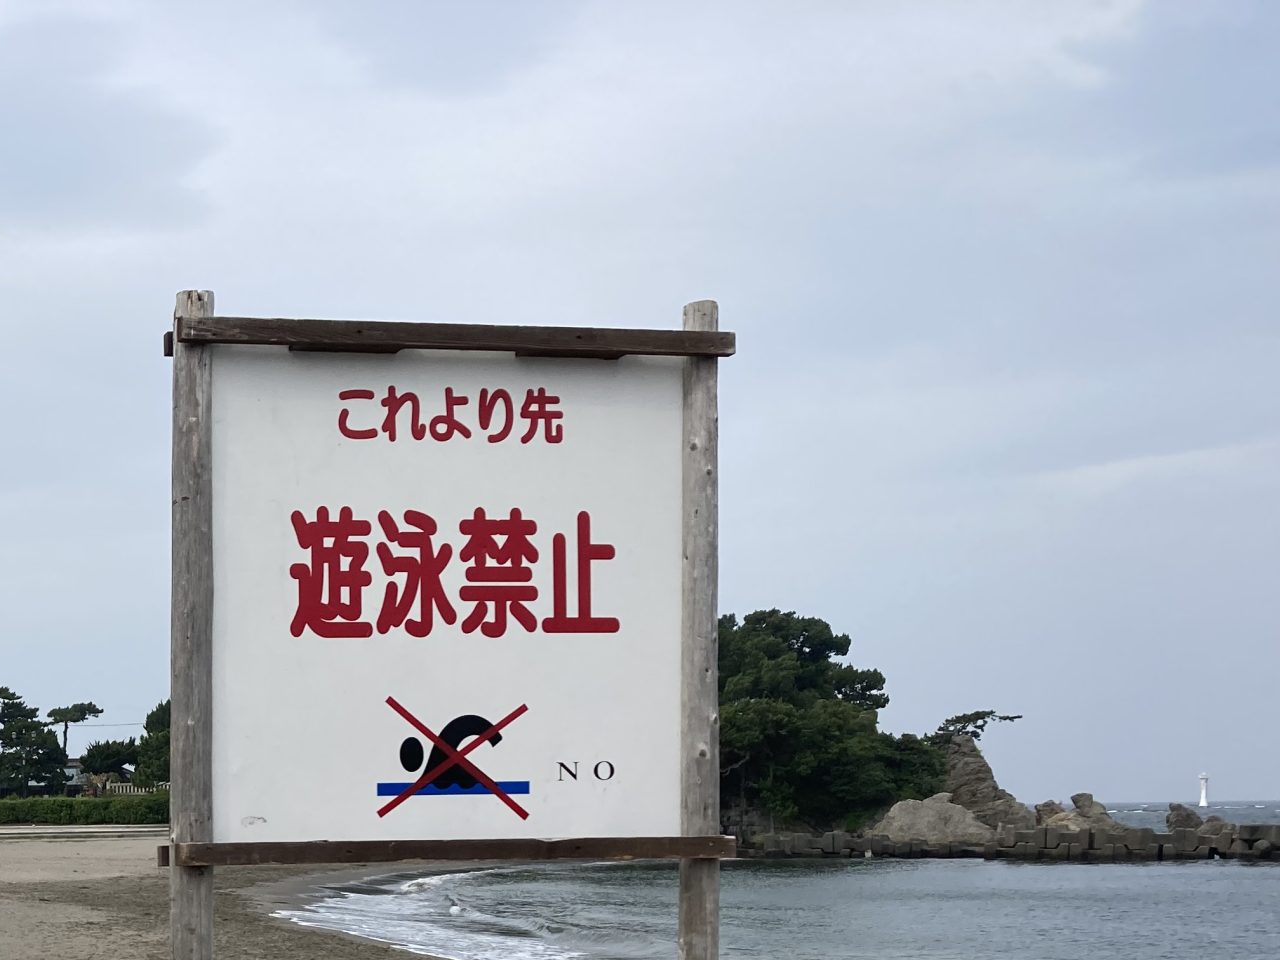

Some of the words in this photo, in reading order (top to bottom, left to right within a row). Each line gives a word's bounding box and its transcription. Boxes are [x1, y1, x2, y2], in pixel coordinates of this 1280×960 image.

[338, 385, 563, 444] これより先
[289, 505, 620, 639] 遊泳禁止
[556, 760, 615, 782] NO
